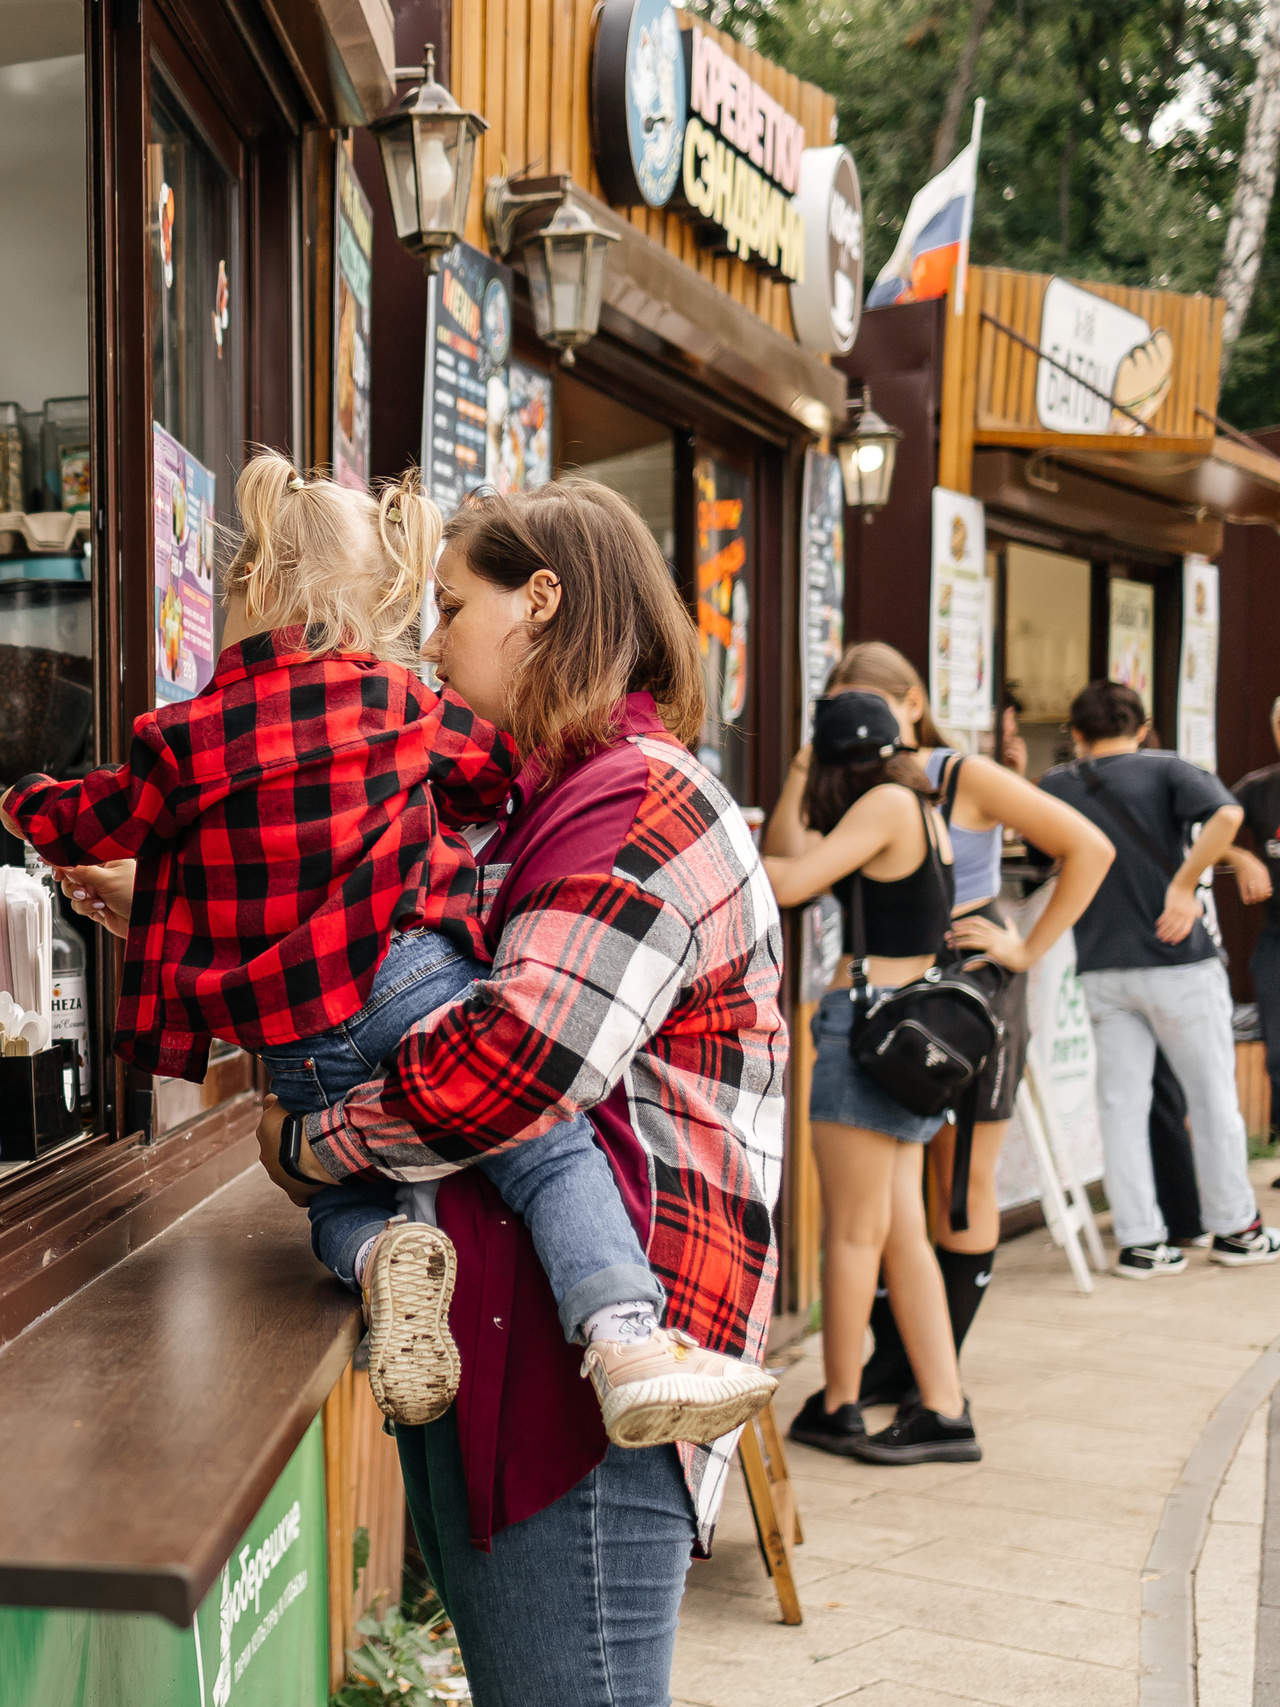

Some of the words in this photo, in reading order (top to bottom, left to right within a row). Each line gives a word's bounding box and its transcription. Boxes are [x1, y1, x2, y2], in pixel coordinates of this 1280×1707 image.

[691, 25, 805, 196] КРЕВЕТКИ
[683, 117, 806, 286] СЭНДВИЧИ
[52, 997, 82, 1011] HEZA
